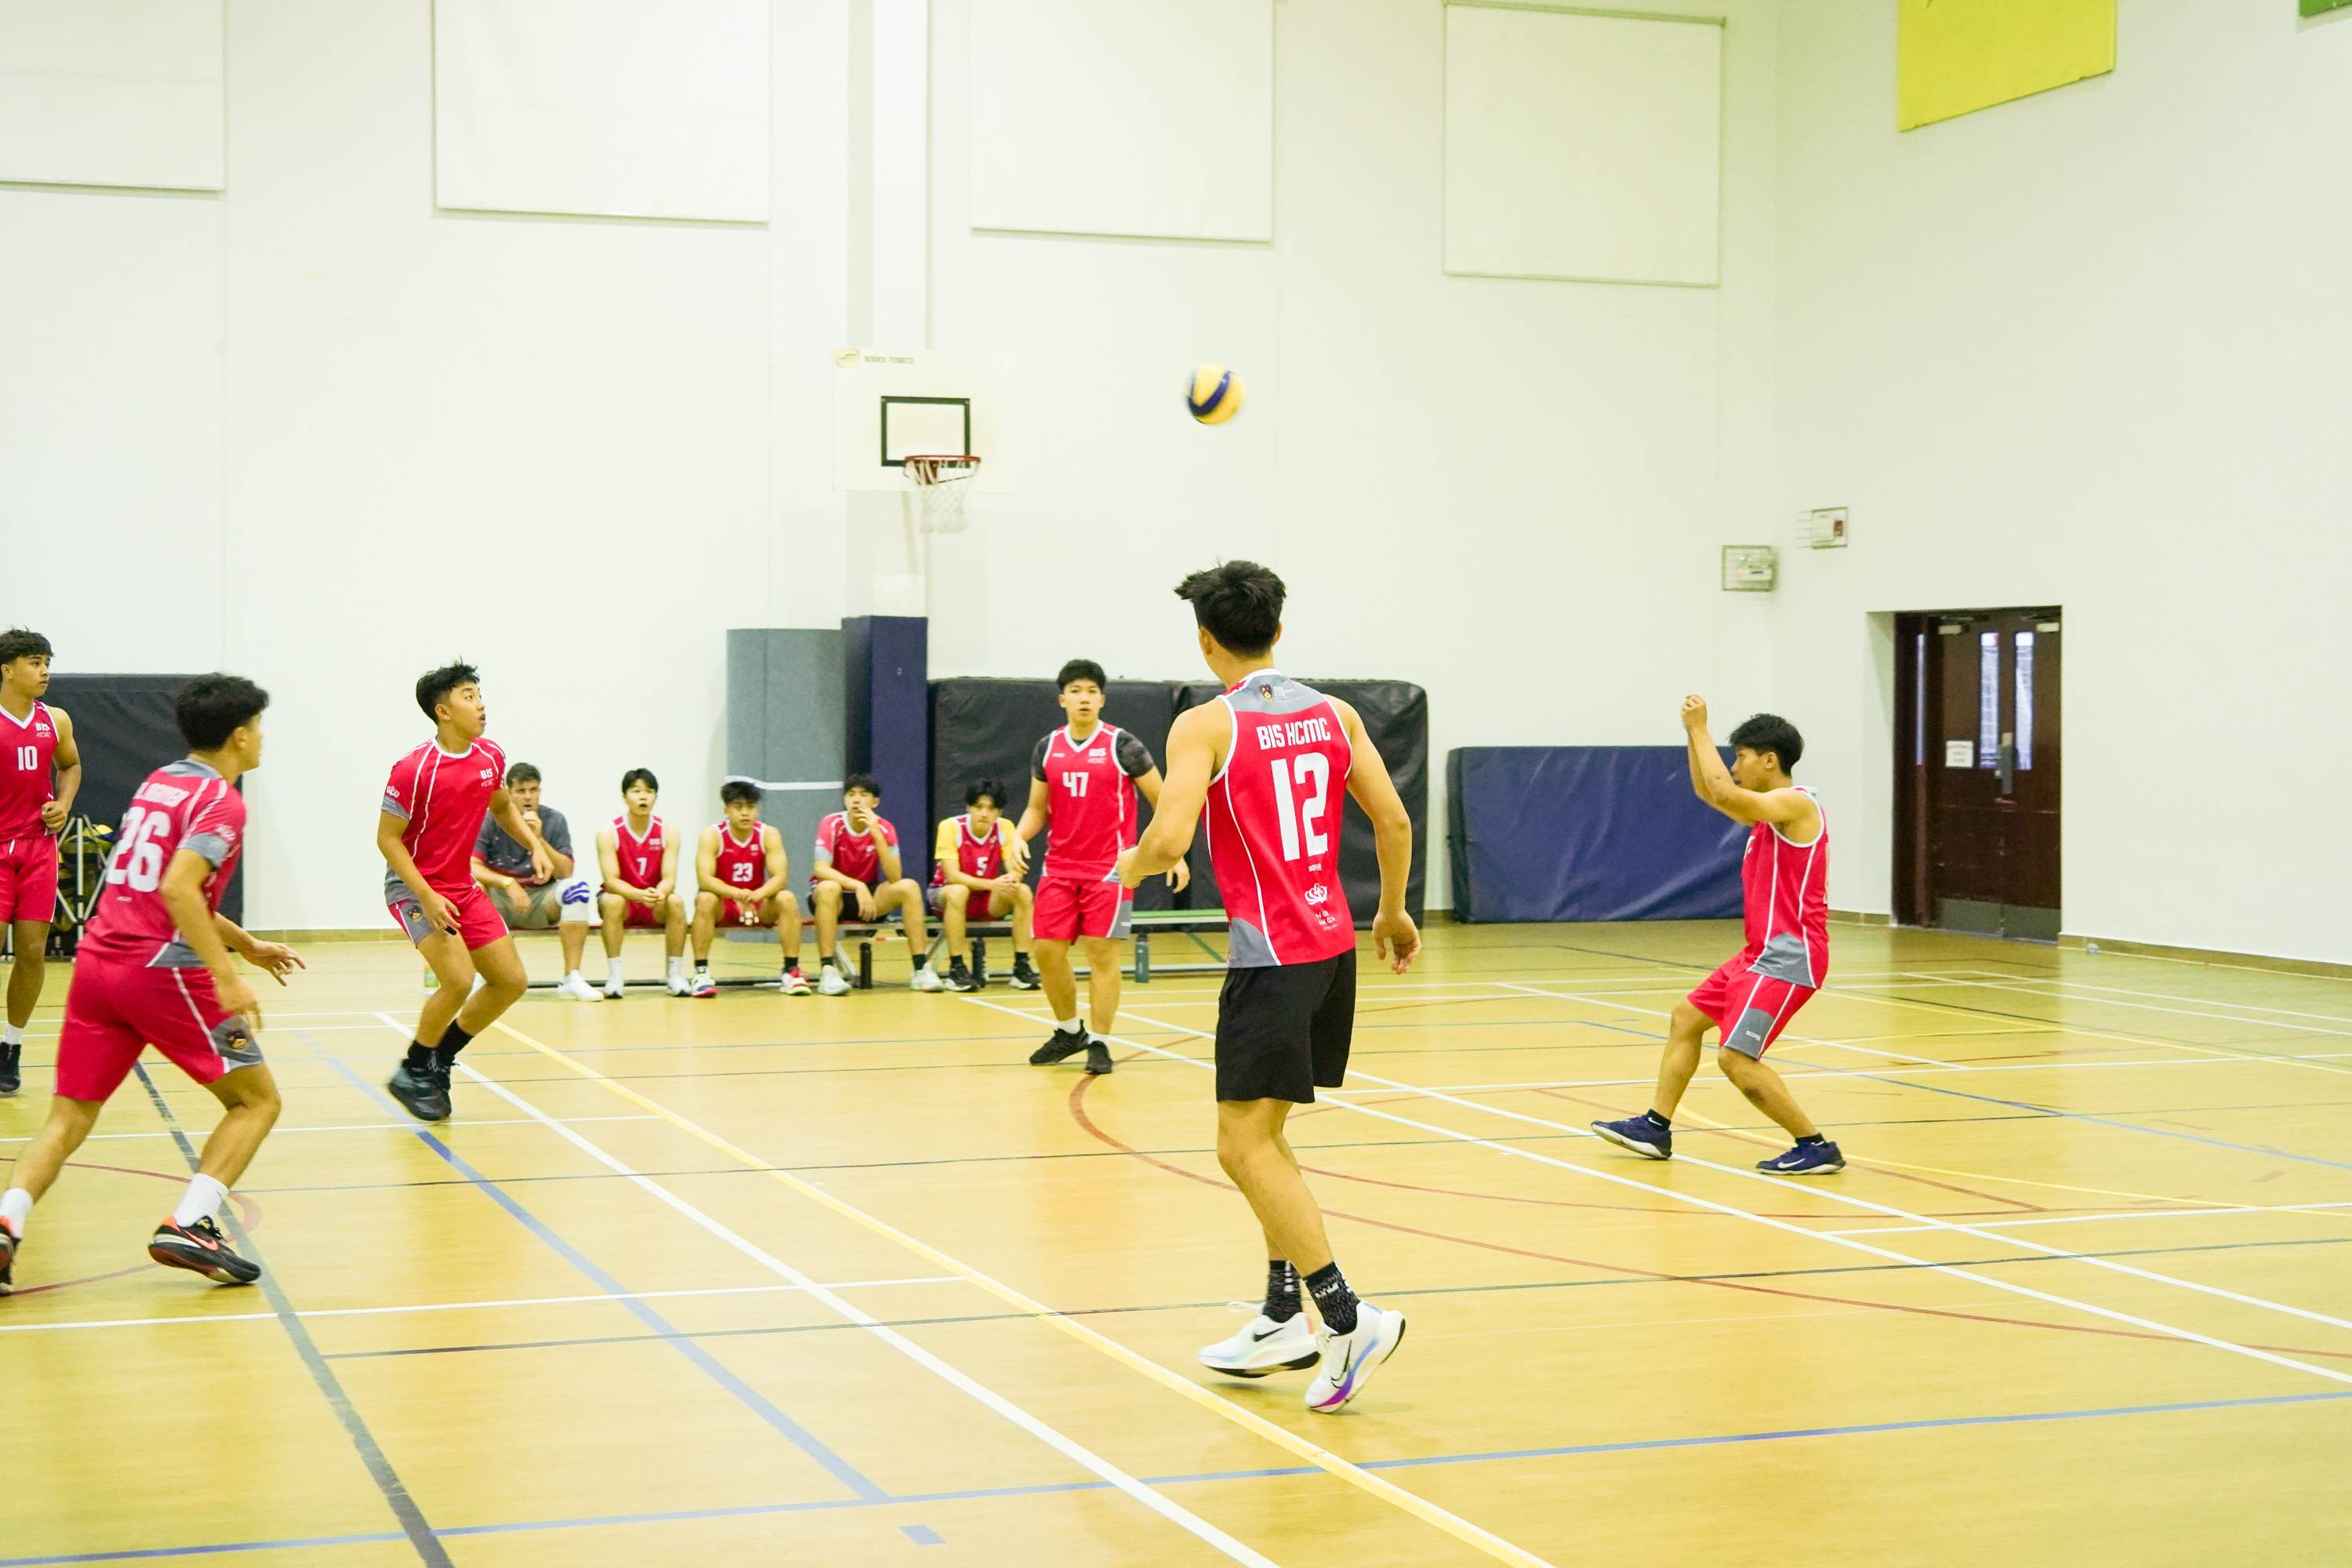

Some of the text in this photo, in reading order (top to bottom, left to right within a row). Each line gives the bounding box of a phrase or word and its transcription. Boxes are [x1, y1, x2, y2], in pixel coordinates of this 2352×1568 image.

[1256, 717, 1331, 750] BIS HCMC
[17, 746, 38, 771] 10
[480, 768, 493, 779] BIS
[1062, 771, 1090, 797] 47
[1270, 752, 1330, 862] 12
[105, 805, 172, 893] 26
[637, 857, 648, 877] 7
[731, 862, 753, 883] 23
[976, 856, 989, 877] 5
